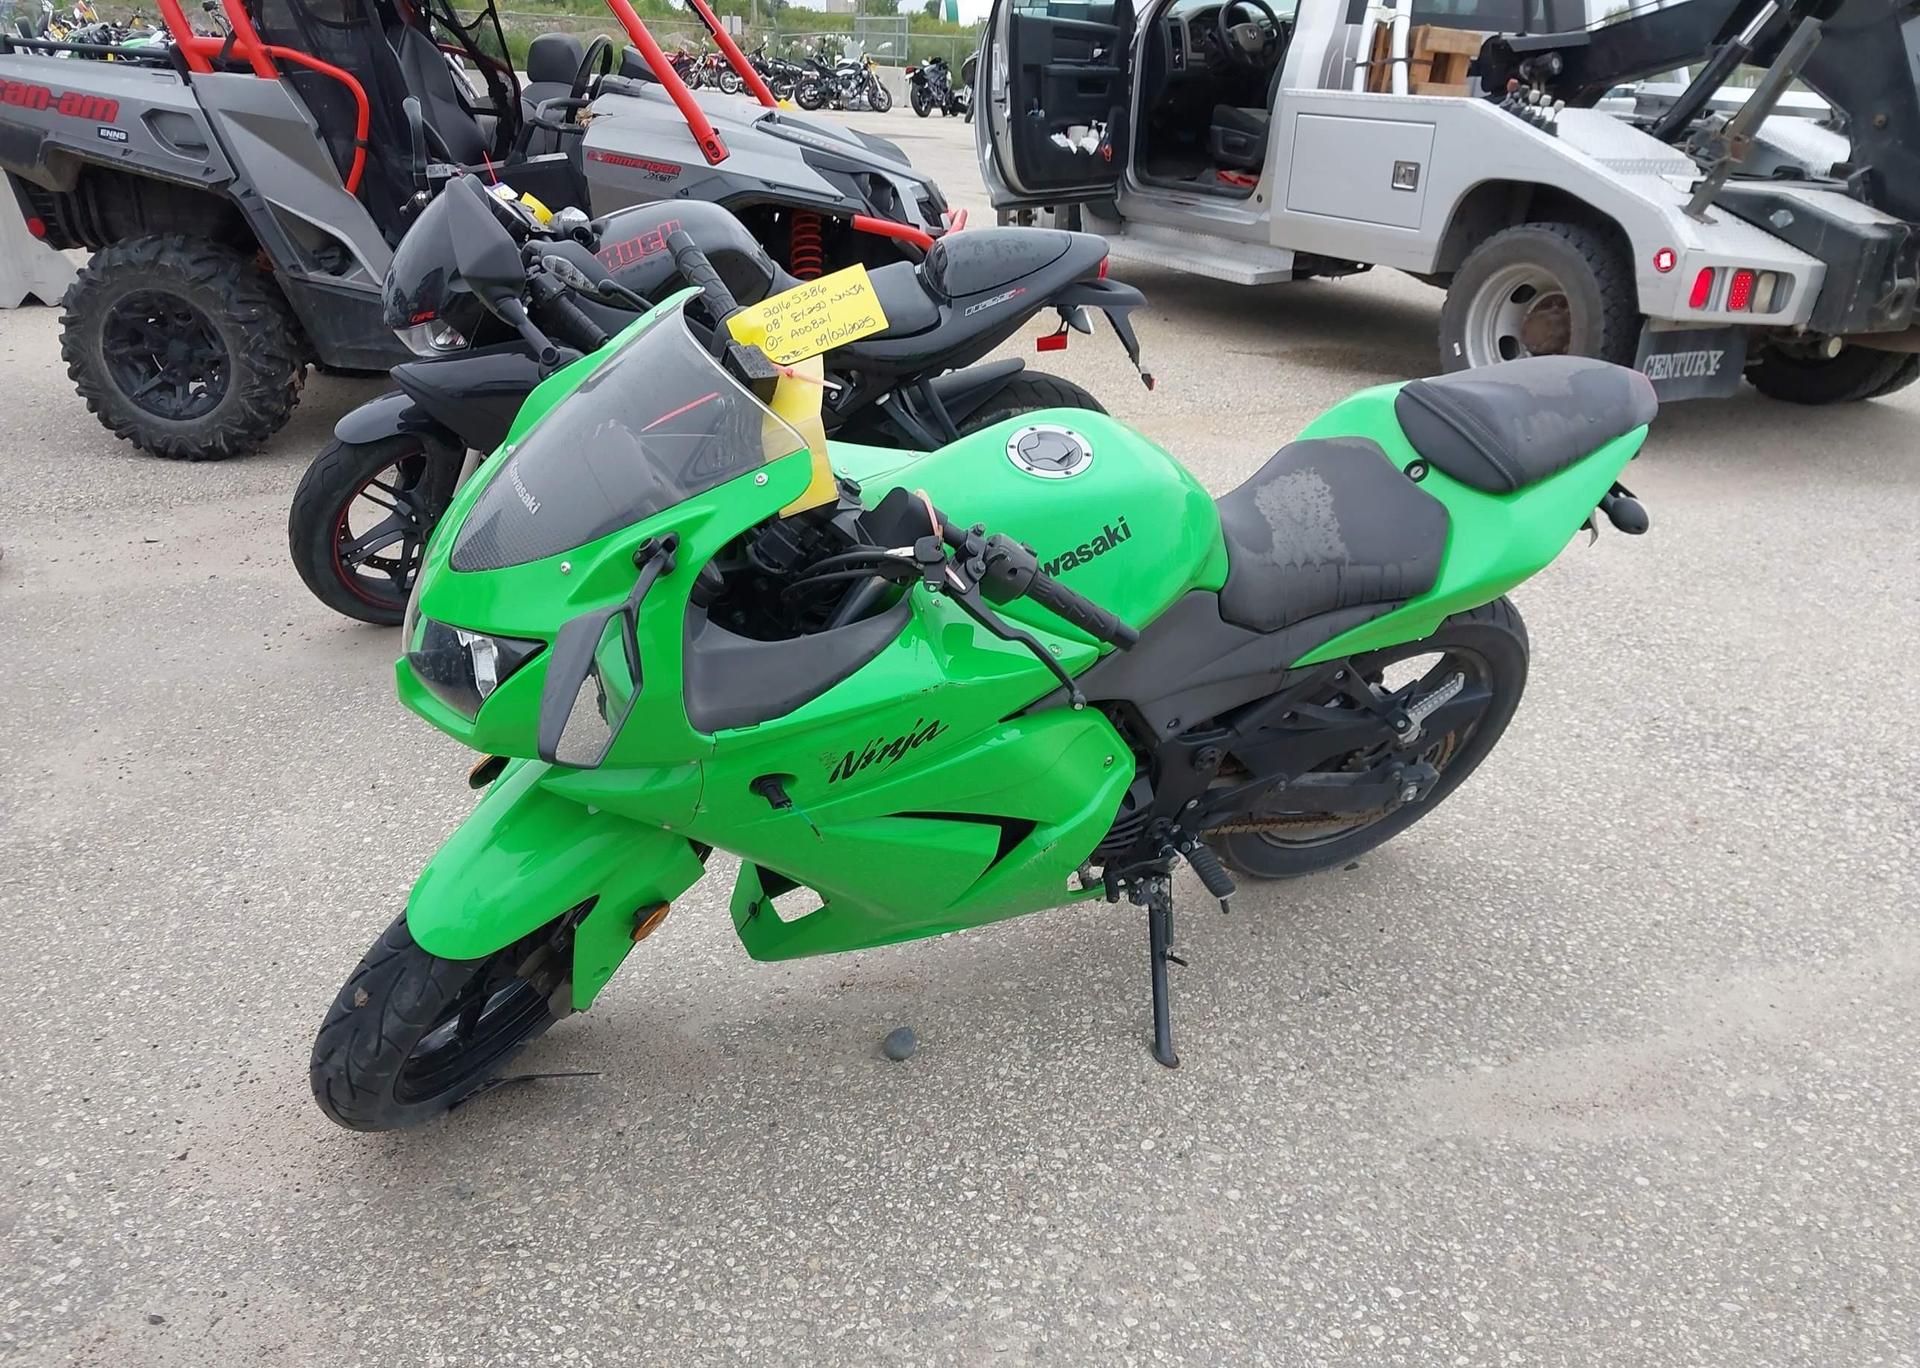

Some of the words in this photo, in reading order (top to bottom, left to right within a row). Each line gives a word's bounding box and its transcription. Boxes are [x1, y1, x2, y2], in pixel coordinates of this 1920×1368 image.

[100, 128, 127, 140] ENNS
[1642, 350, 1724, 380] CENTURY
[1039, 515, 1132, 578] wasaki
[828, 717, 950, 784] Ninja
